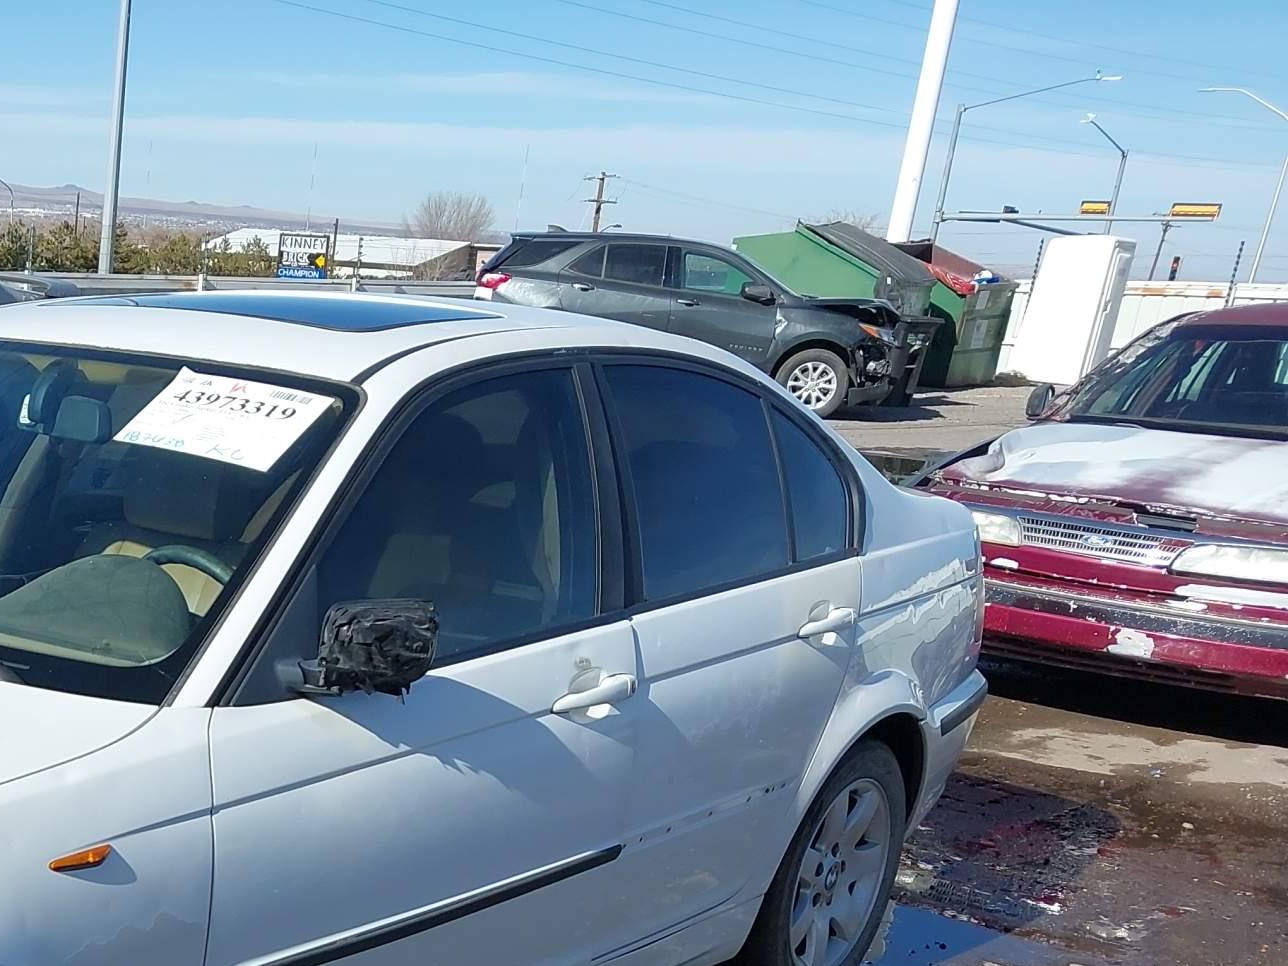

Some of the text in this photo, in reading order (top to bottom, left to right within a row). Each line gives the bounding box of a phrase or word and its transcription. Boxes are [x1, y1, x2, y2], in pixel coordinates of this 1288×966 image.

[282, 236, 326, 250] KINNEY
[282, 251, 310, 263] BRICK
[278, 268, 320, 278] CHAMPION
[174, 389, 297, 420] 43973319
